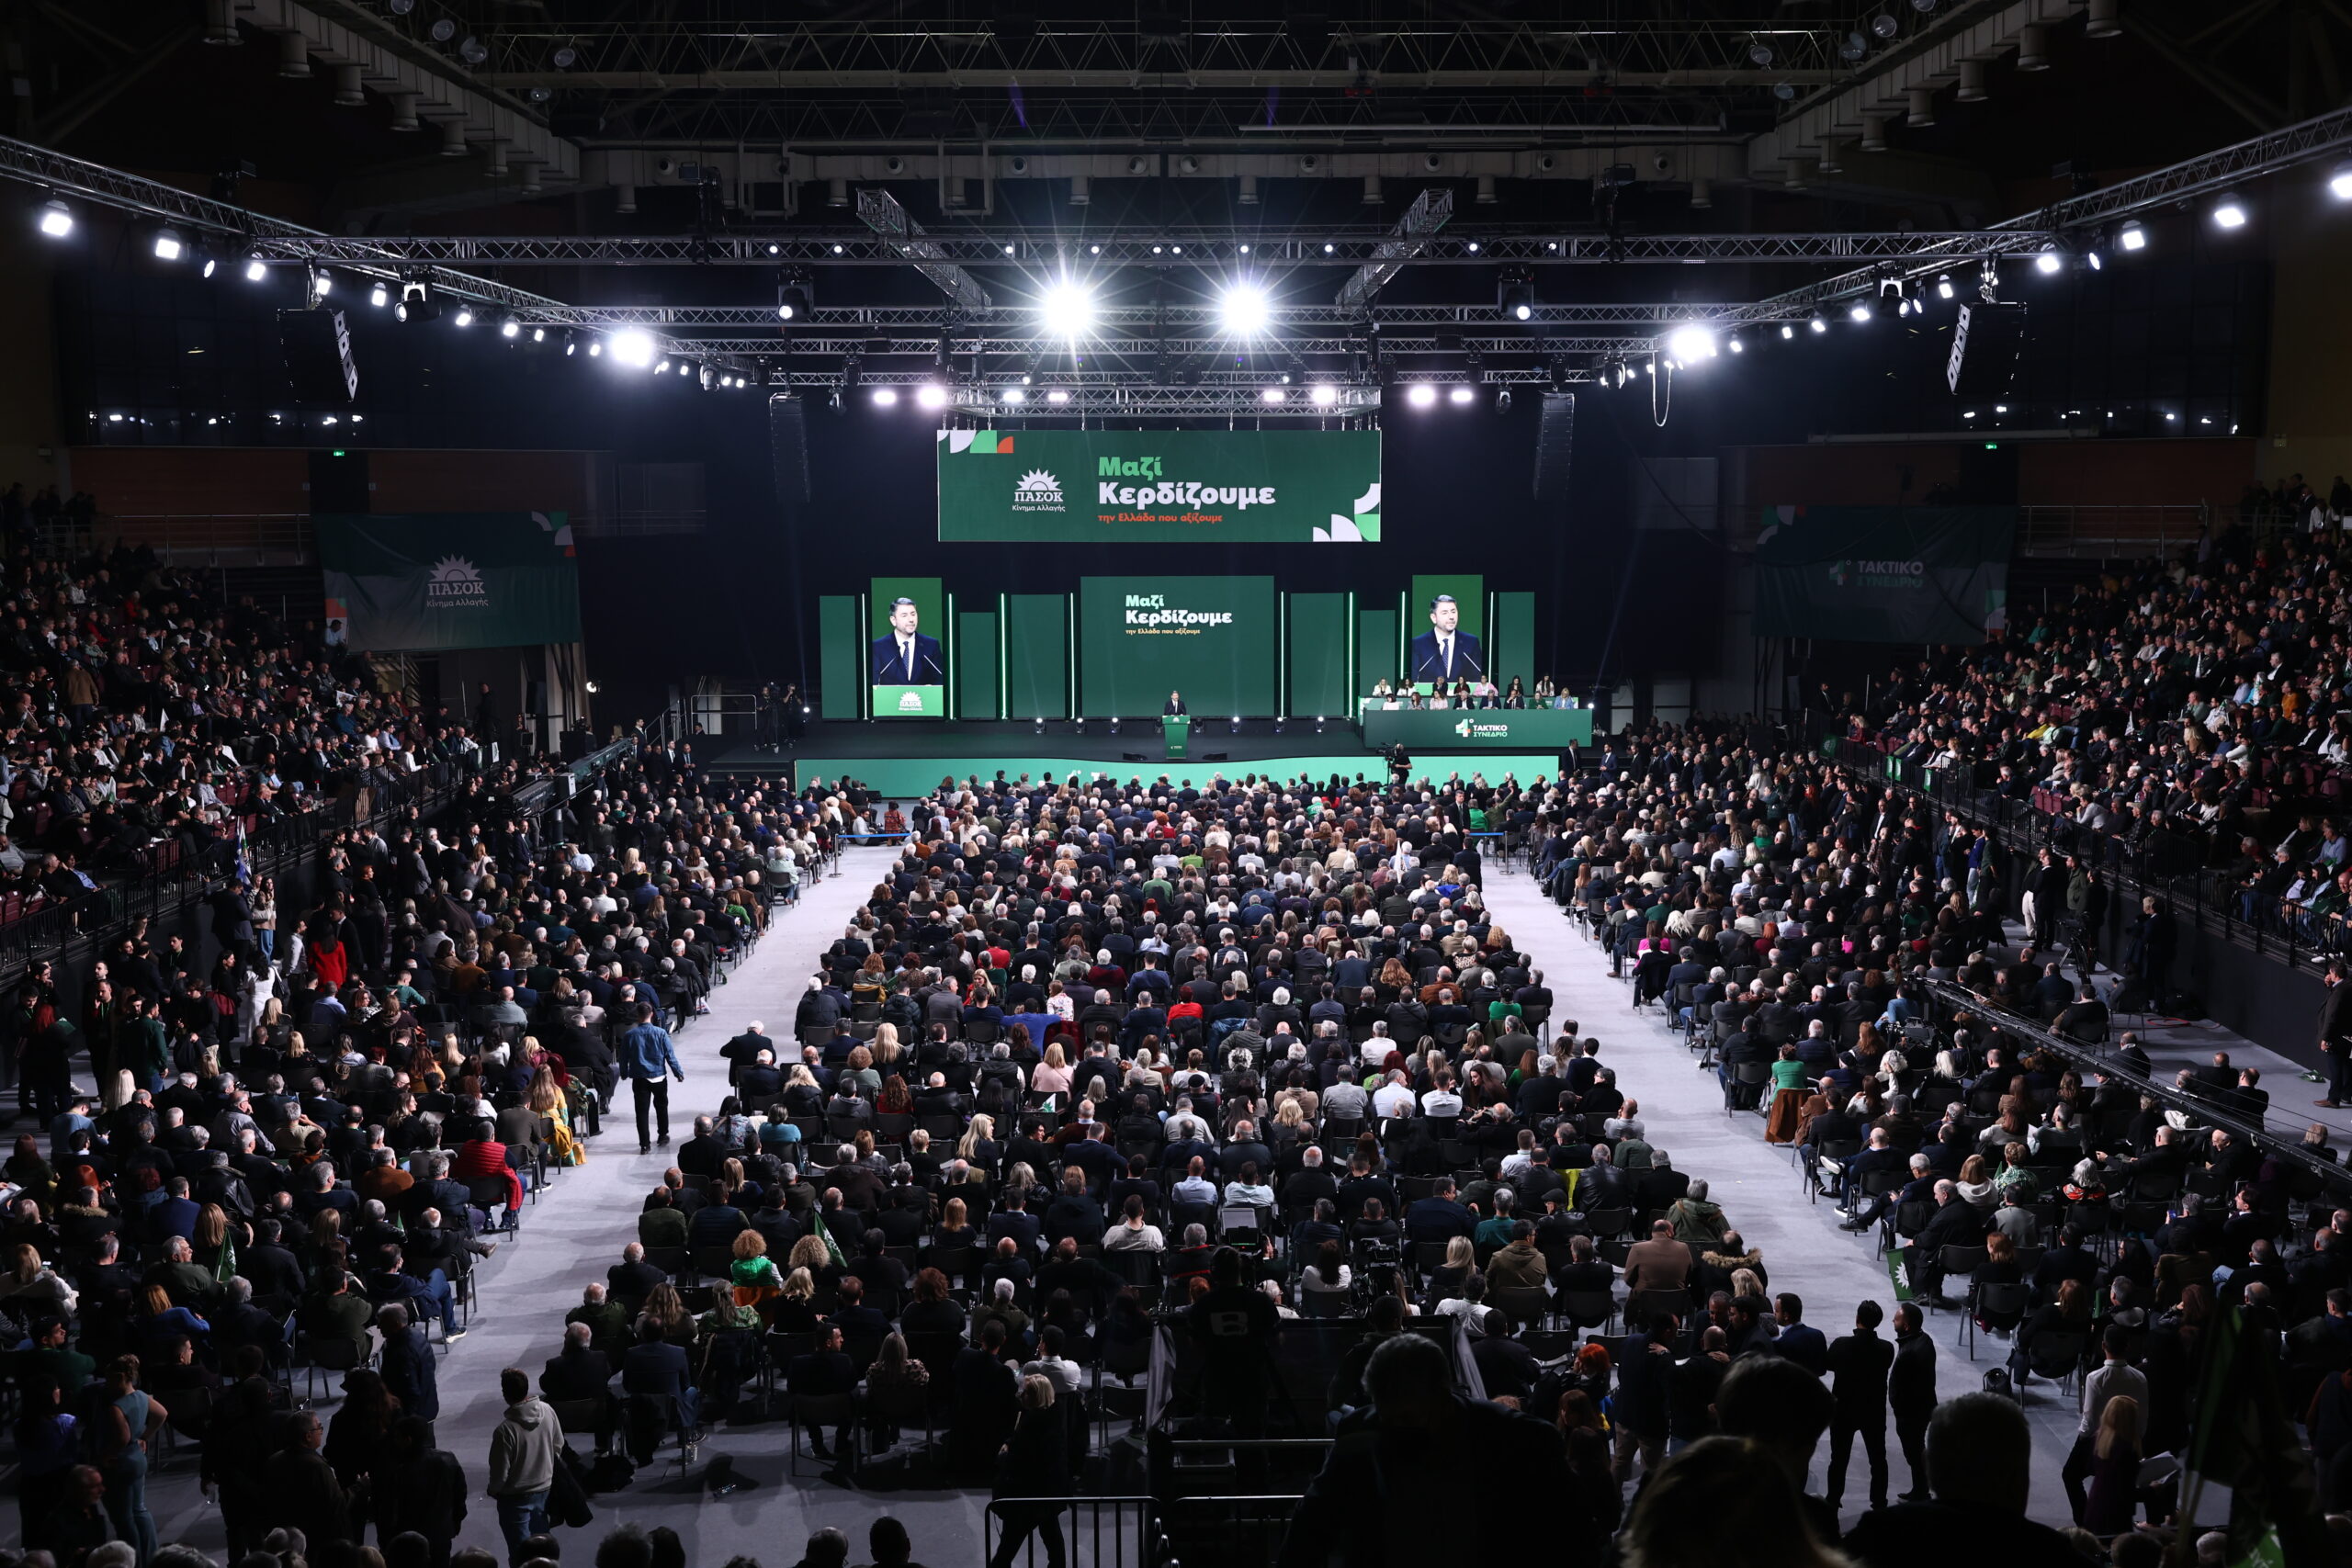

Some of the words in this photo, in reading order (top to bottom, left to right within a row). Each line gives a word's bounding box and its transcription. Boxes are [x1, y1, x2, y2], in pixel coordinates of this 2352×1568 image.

[1098, 457, 1163, 480] Μαζί
[1013, 491, 1064, 502] ΠΑΣΟΚ
[1099, 481, 1276, 510] Κερδίζουμε
[1012, 504, 1035, 513] Κίνημα
[1036, 504, 1066, 513] Αλλαγής
[1098, 514, 1115, 525] την
[1117, 512, 1156, 523] Ελλάδα
[1180, 512, 1223, 525] αξίζουμε
[1858, 560, 1924, 575] ΤΑΚΤΙΚΟ
[428, 582, 485, 595] ΠΑΣΟΚ
[1857, 577, 1924, 588] ΣΥΝΕΔΡΙΟ
[426, 599, 455, 608] Κίνημα
[456, 597, 489, 607] Αλλαγής
[1125, 594, 1165, 610] Μαζί
[1125, 610, 1233, 626] Κερδίζουμε
